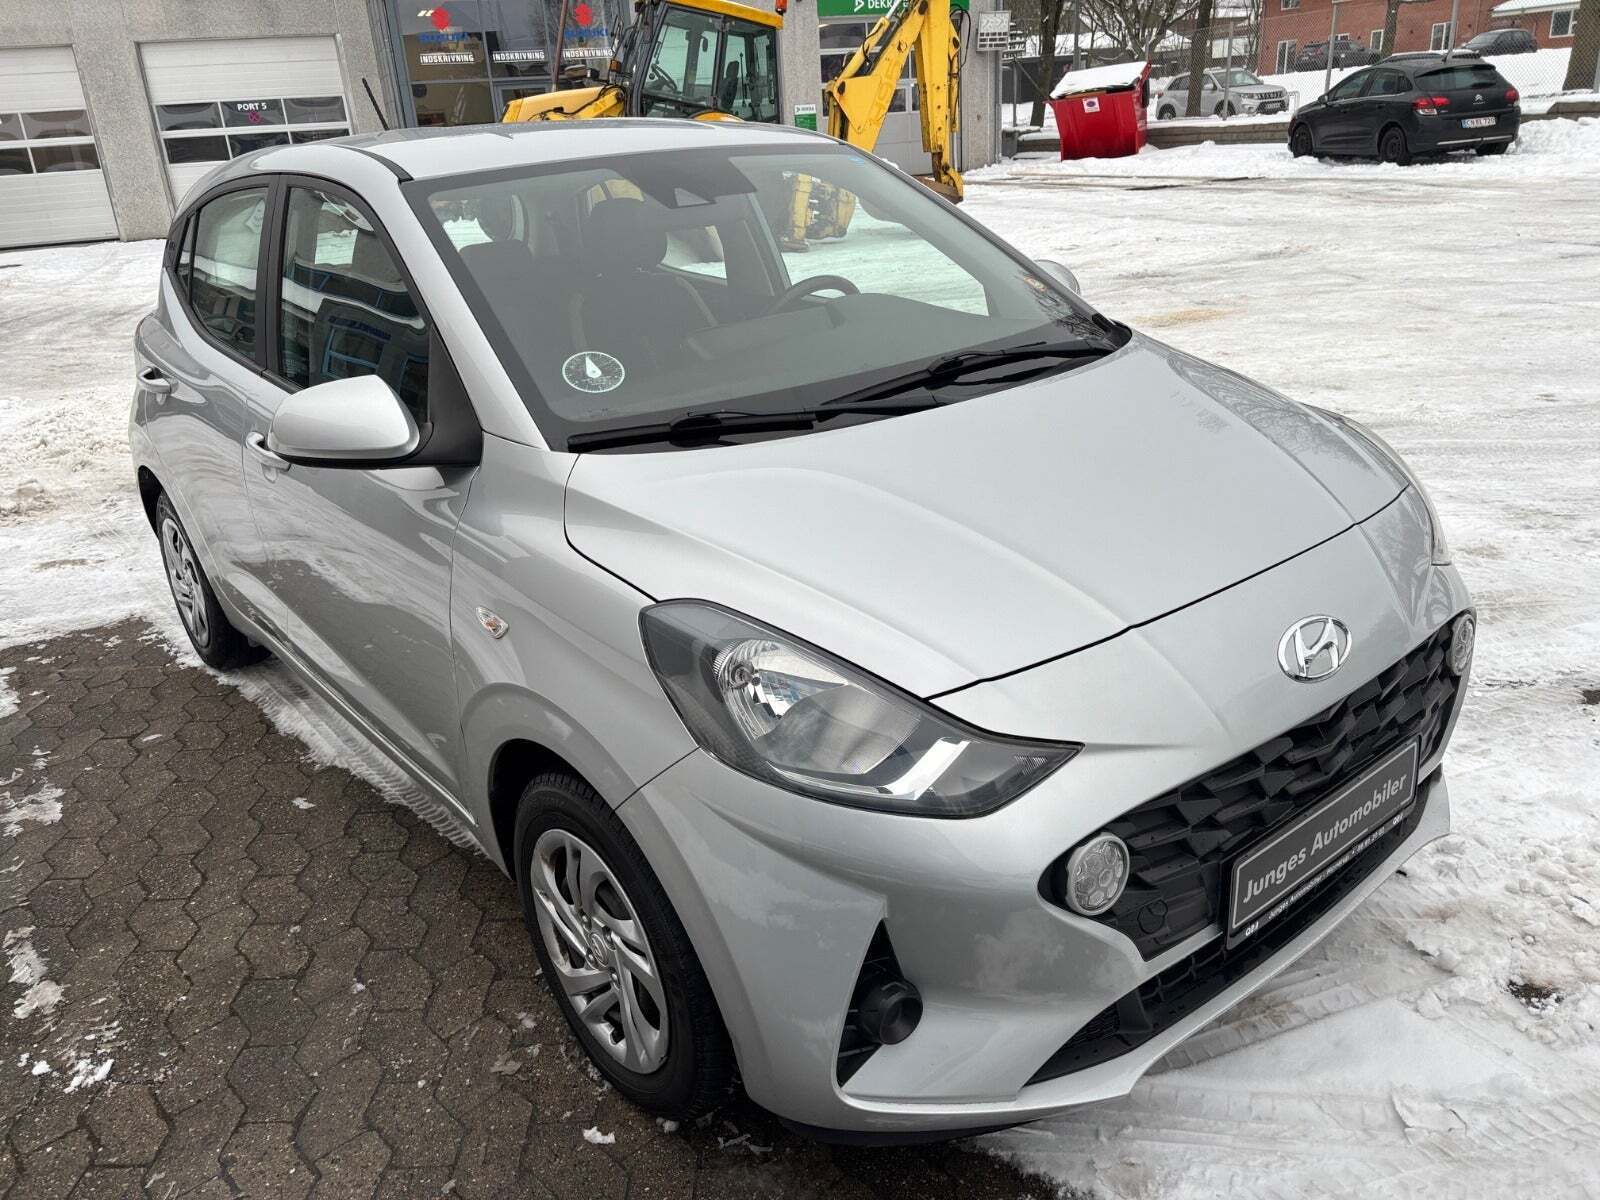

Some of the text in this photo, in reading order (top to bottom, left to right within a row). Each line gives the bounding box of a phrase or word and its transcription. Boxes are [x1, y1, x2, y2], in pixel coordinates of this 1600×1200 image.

[420, 54, 474, 64] INDSKRIVNING
[493, 51, 545, 61] INDSKRIVNING
[237, 102, 267, 111] PORT 5
[1243, 848, 1306, 904] Junges
[1310, 774, 1407, 856] Automobiler
